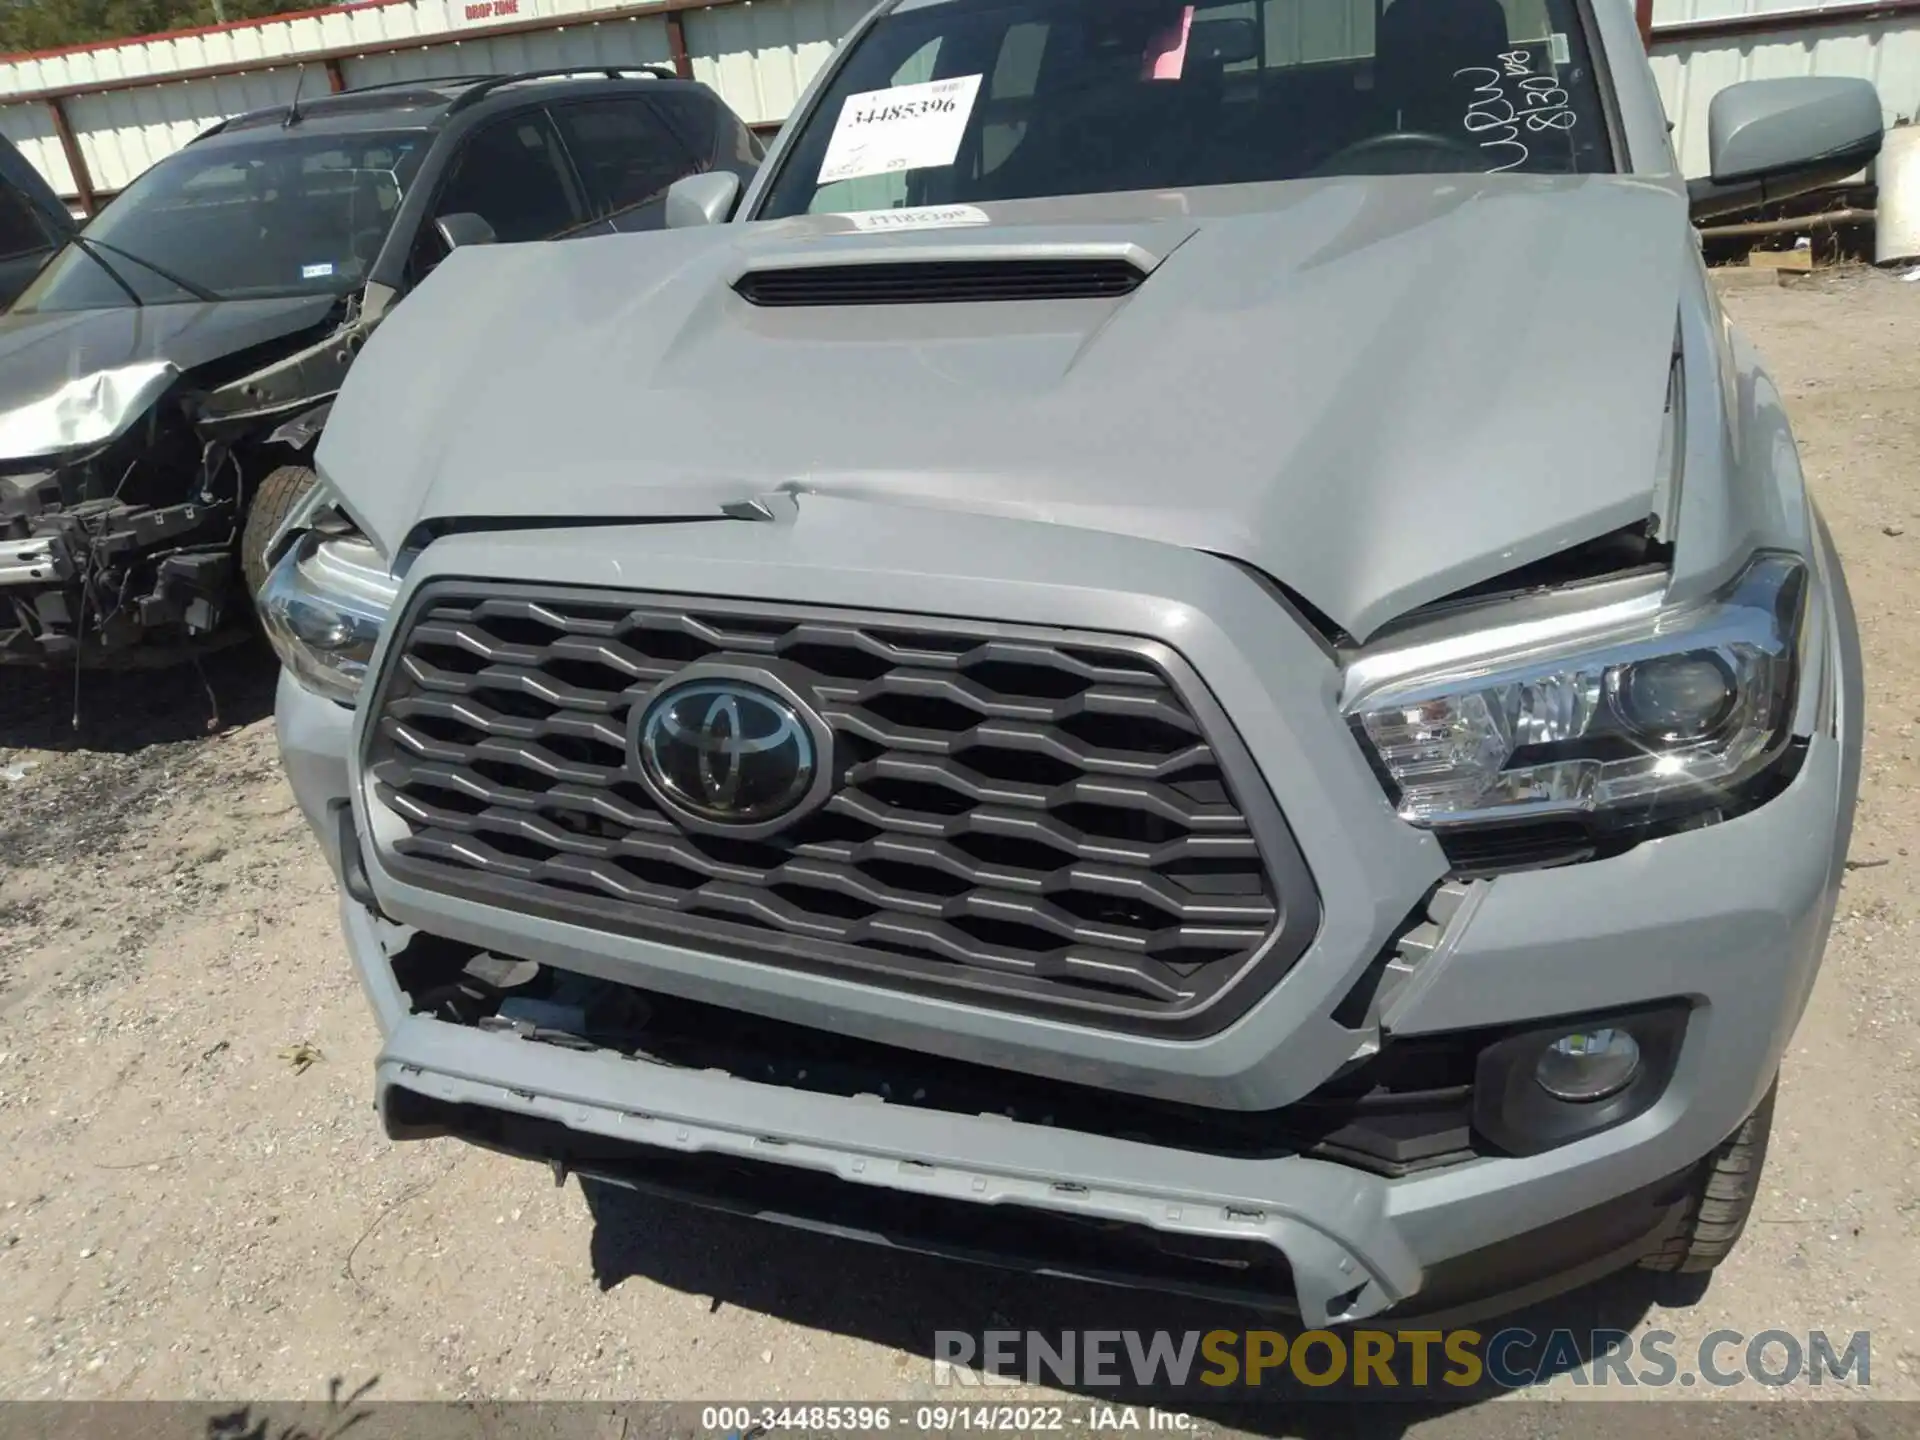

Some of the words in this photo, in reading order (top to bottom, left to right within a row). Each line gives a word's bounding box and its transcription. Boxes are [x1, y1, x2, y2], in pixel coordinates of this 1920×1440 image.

[465, 3, 492, 20] DROP
[494, 0, 518, 16] ZONE
[848, 98, 957, 128] 34485396
